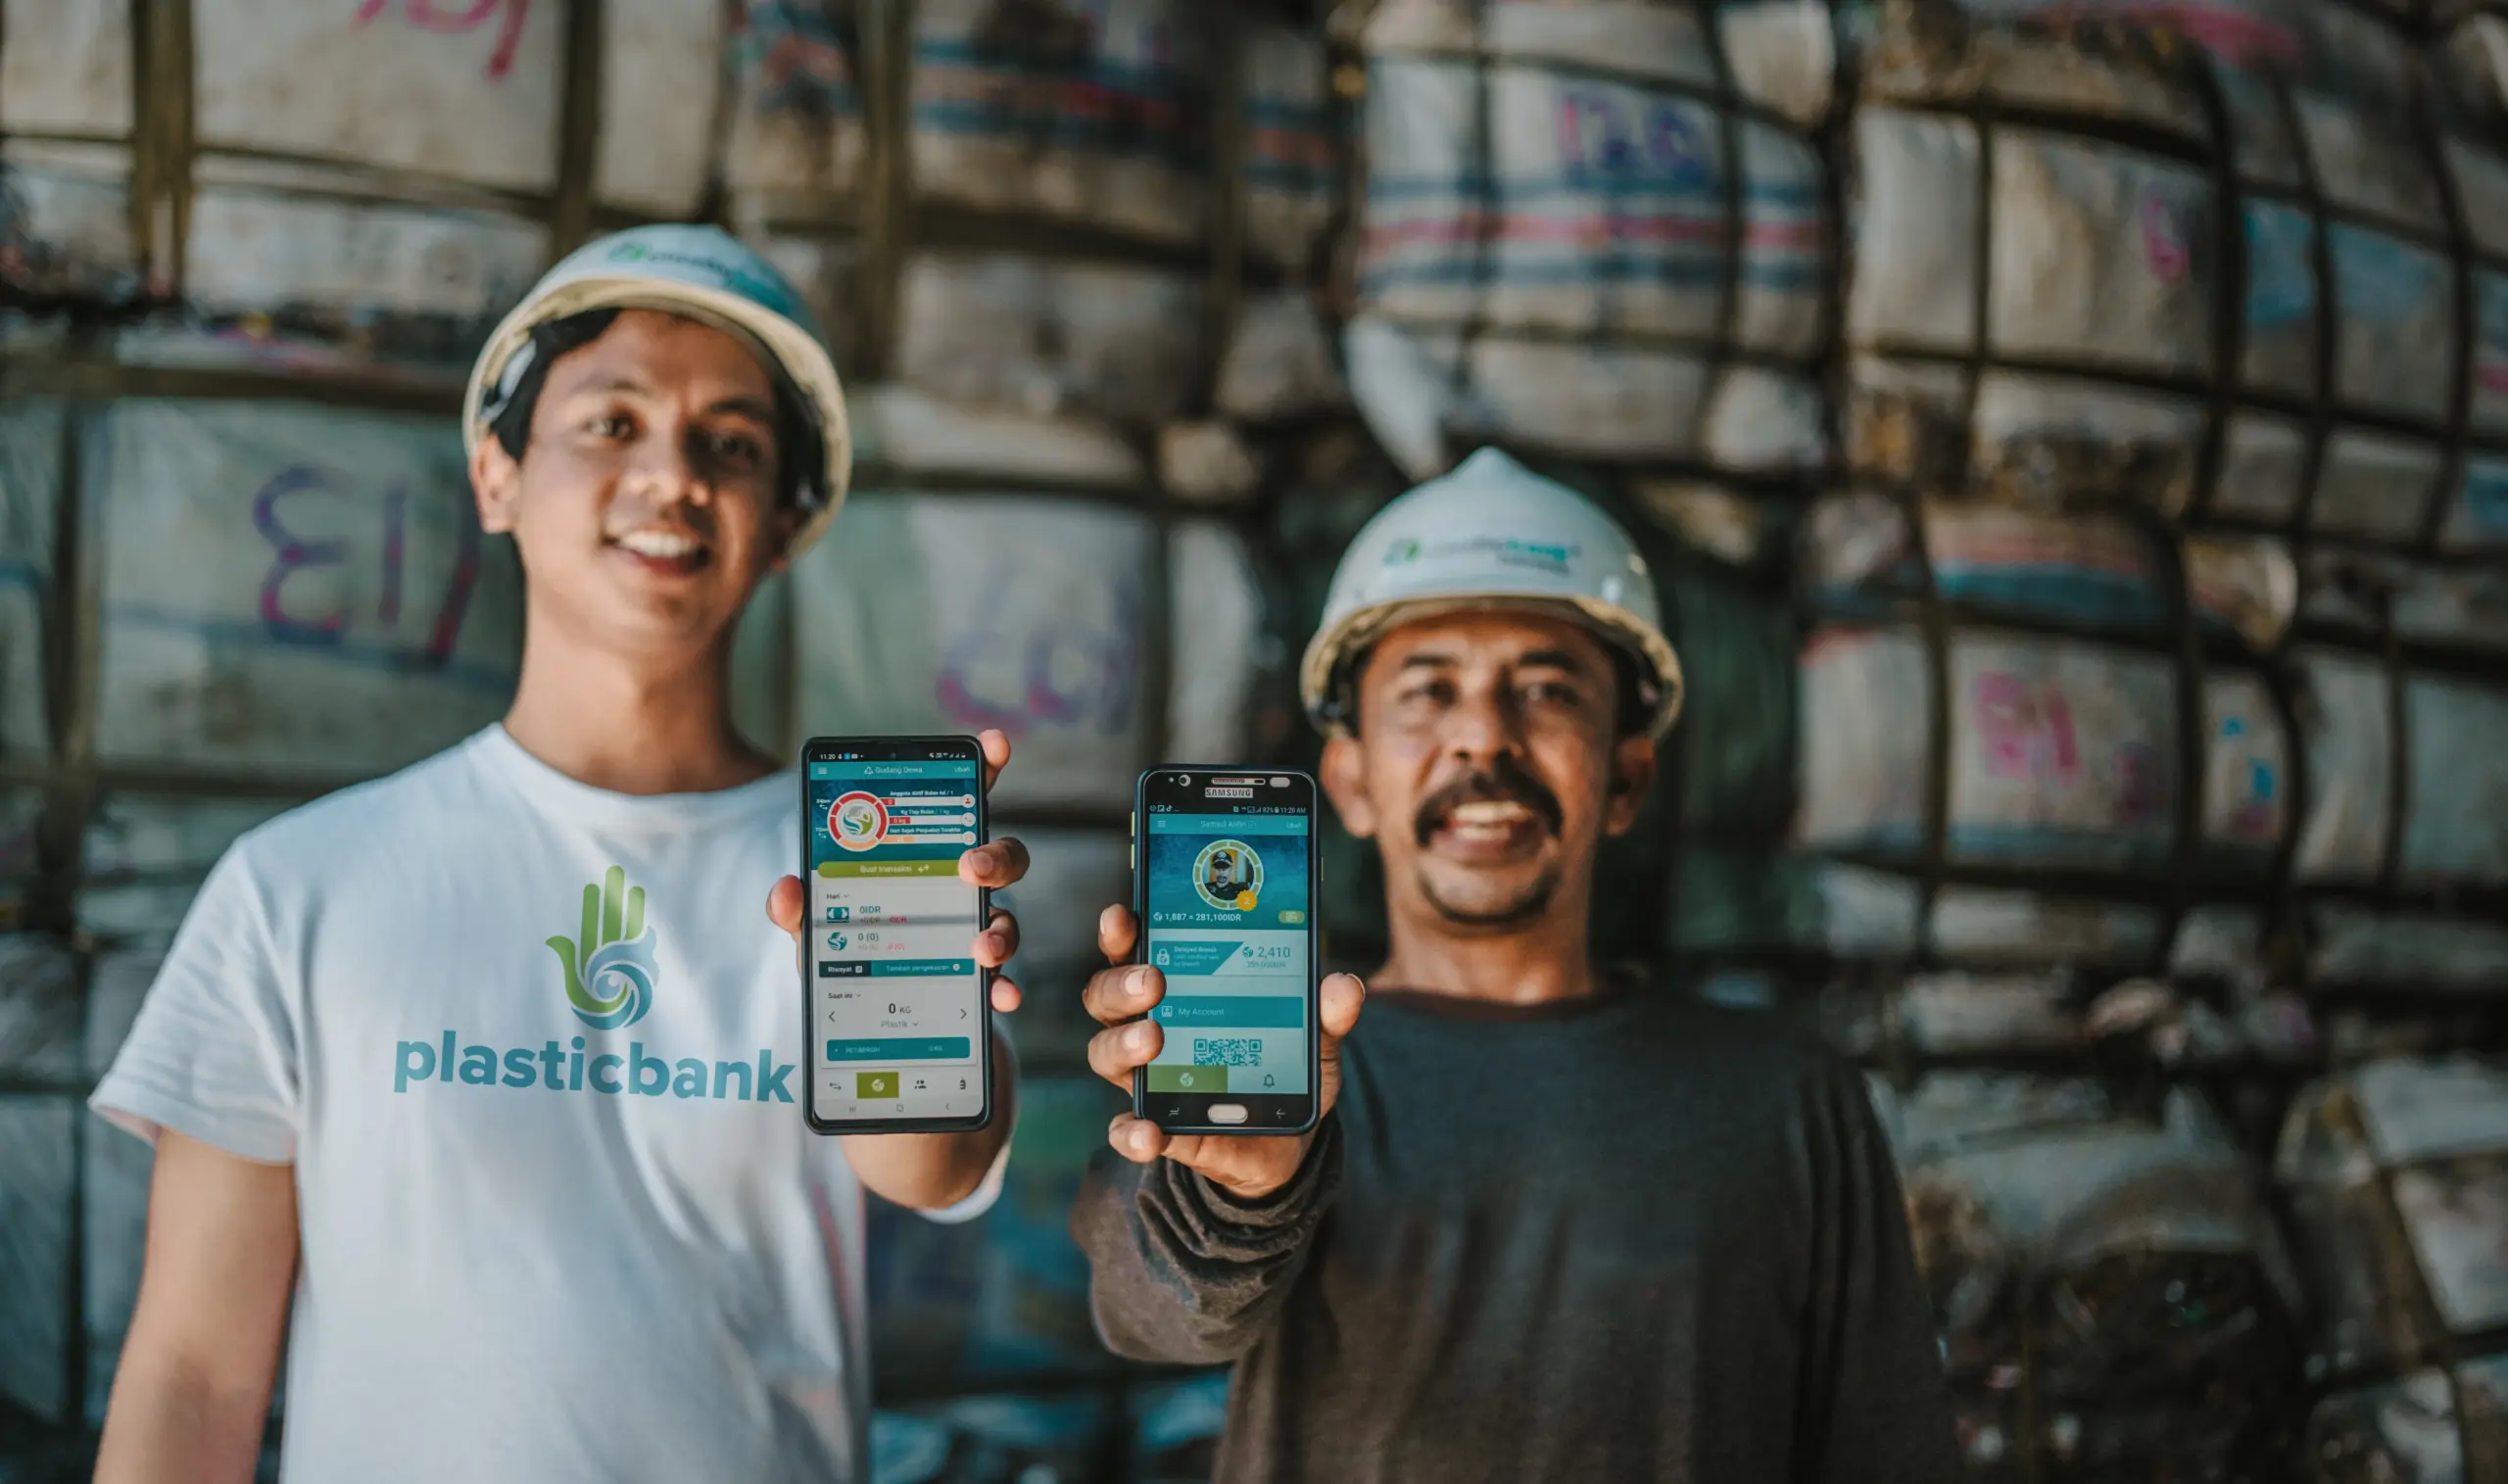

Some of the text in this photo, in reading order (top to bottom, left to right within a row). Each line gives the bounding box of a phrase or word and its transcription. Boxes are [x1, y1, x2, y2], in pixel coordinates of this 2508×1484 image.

[1205, 789, 1251, 797] SAMSUNG
[1257, 946, 1290, 959] 2,410
[889, 1003, 896, 1014] 0
[394, 1029, 796, 1104] plasticbank
